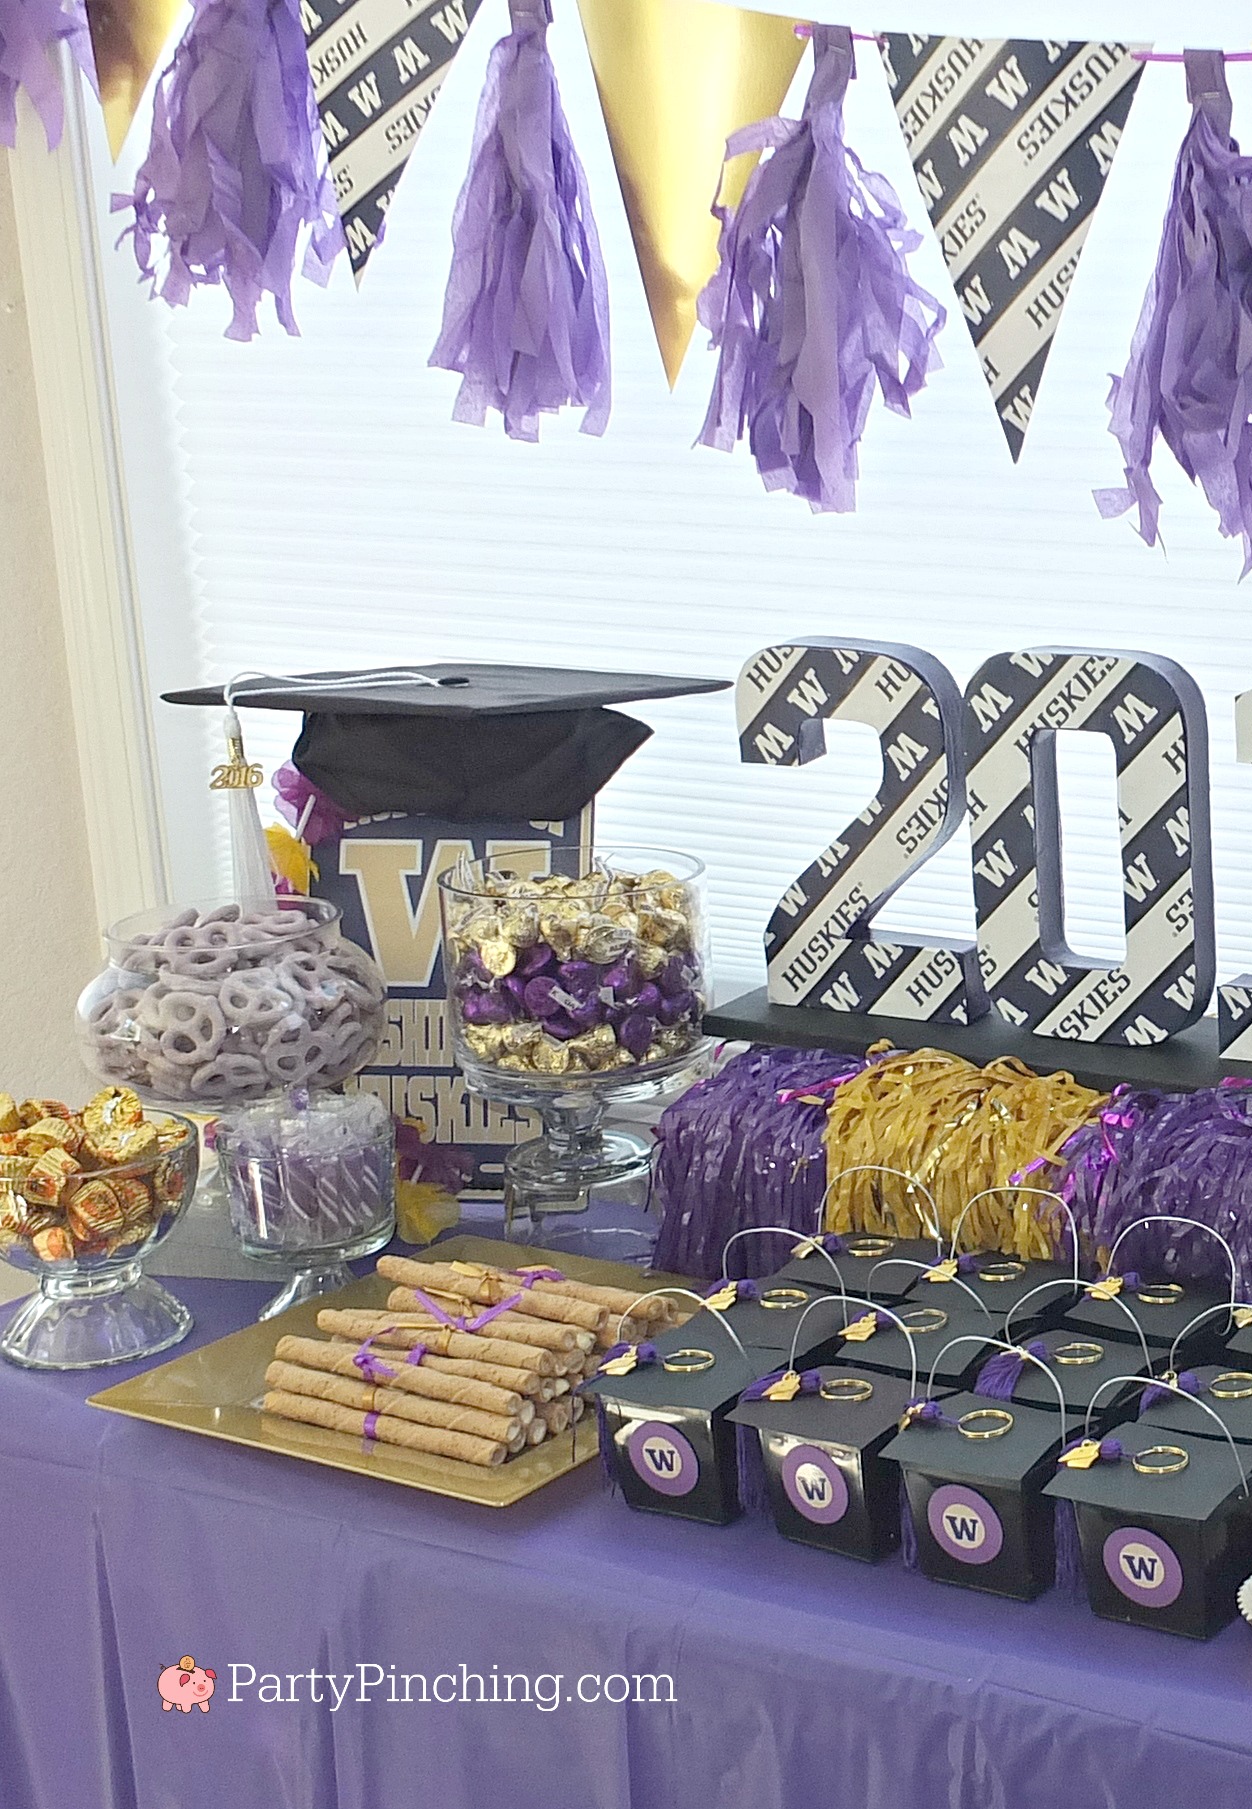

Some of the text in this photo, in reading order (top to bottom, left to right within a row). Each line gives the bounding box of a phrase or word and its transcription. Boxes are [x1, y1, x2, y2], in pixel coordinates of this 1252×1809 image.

[392, 36, 430, 84] W
[986, 55, 1031, 111] W
[348, 71, 383, 118] W
[1017, 42, 1128, 160] HUSKIES
[946, 114, 989, 168] W
[1087, 120, 1122, 176] W
[1036, 167, 1082, 223] W
[344, 217, 377, 259] W
[996, 227, 1040, 280] W
[959, 274, 993, 326] W
[788, 668, 831, 717] W
[969, 683, 1013, 733] W
[753, 722, 794, 765] W
[1111, 693, 1159, 745] W
[209, 763, 263, 789] 2016
[885, 732, 929, 781] W
[974, 838, 1017, 888] W
[781, 886, 869, 993] HUSKIES
[821, 971, 862, 1012] W
[645, 1449, 676, 1472] W
[797, 1475, 827, 1501] W
[945, 1515, 979, 1542] W
[1122, 1554, 1157, 1582] W
